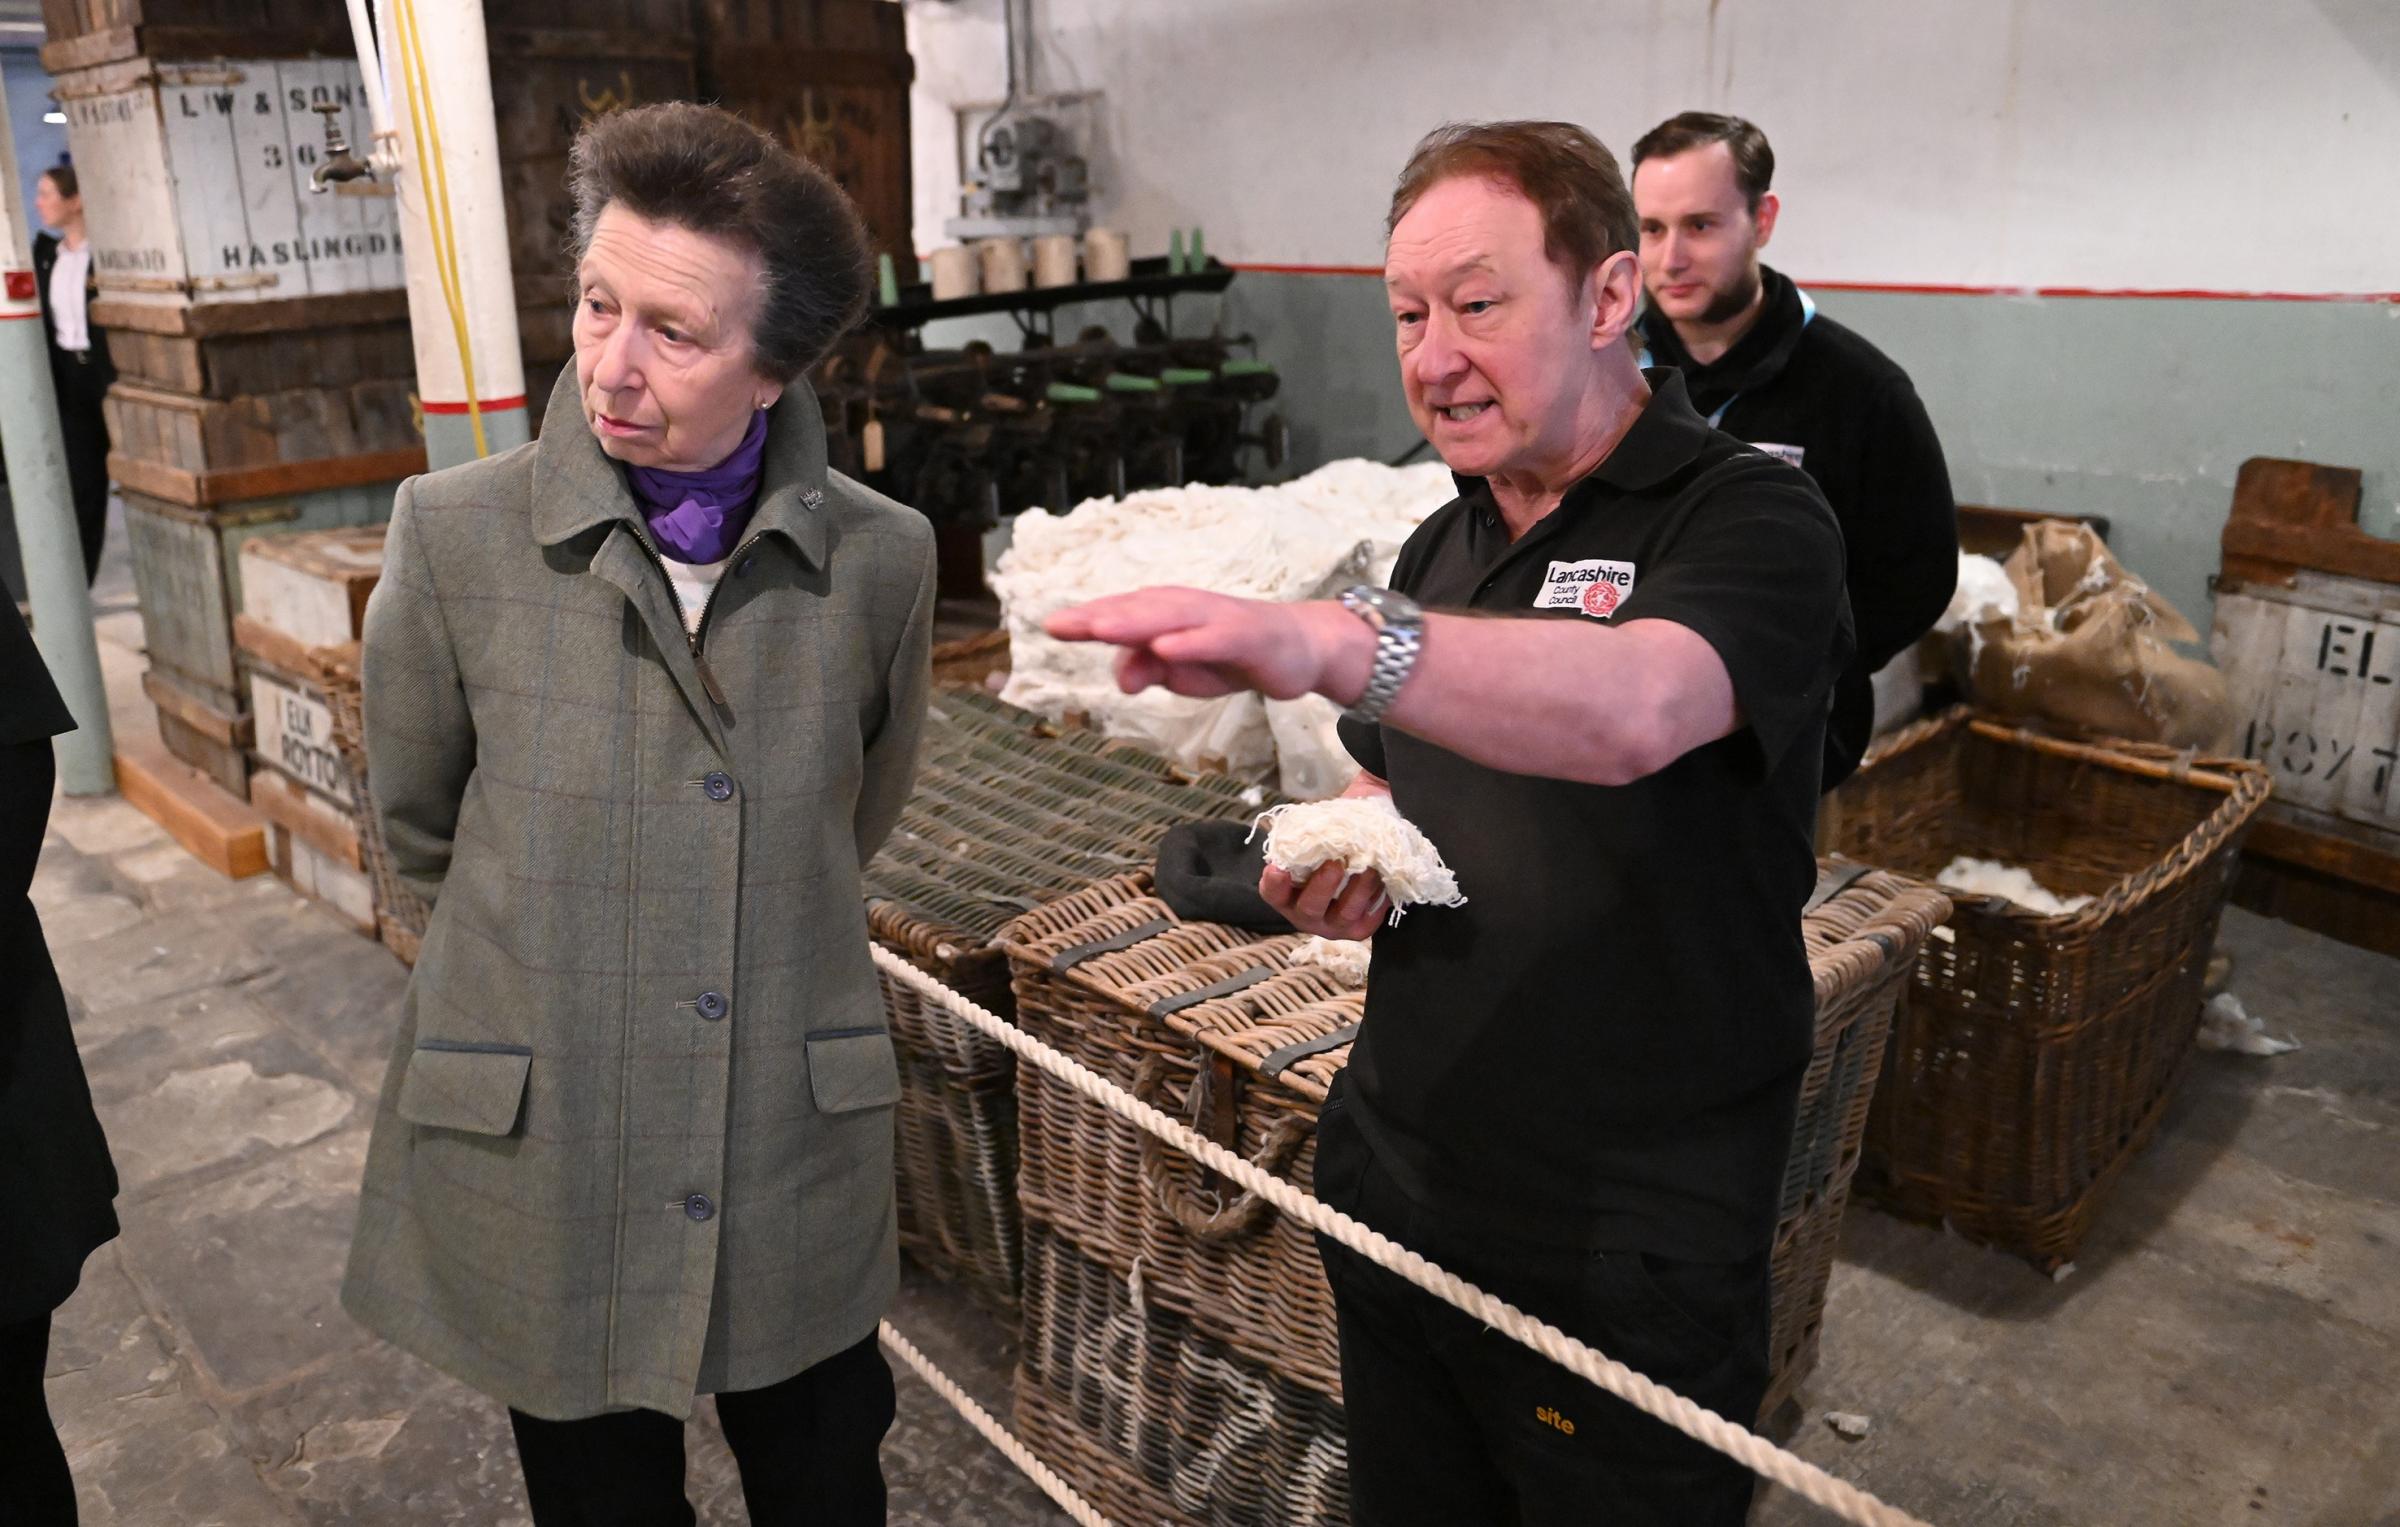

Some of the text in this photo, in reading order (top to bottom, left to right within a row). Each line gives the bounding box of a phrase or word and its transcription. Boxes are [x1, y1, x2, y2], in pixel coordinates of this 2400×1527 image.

[254, 91, 271, 115] &
[1548, 565, 1631, 587] Lancashire
[1553, 585, 1581, 595] County
[1548, 595, 1578, 605] Council
